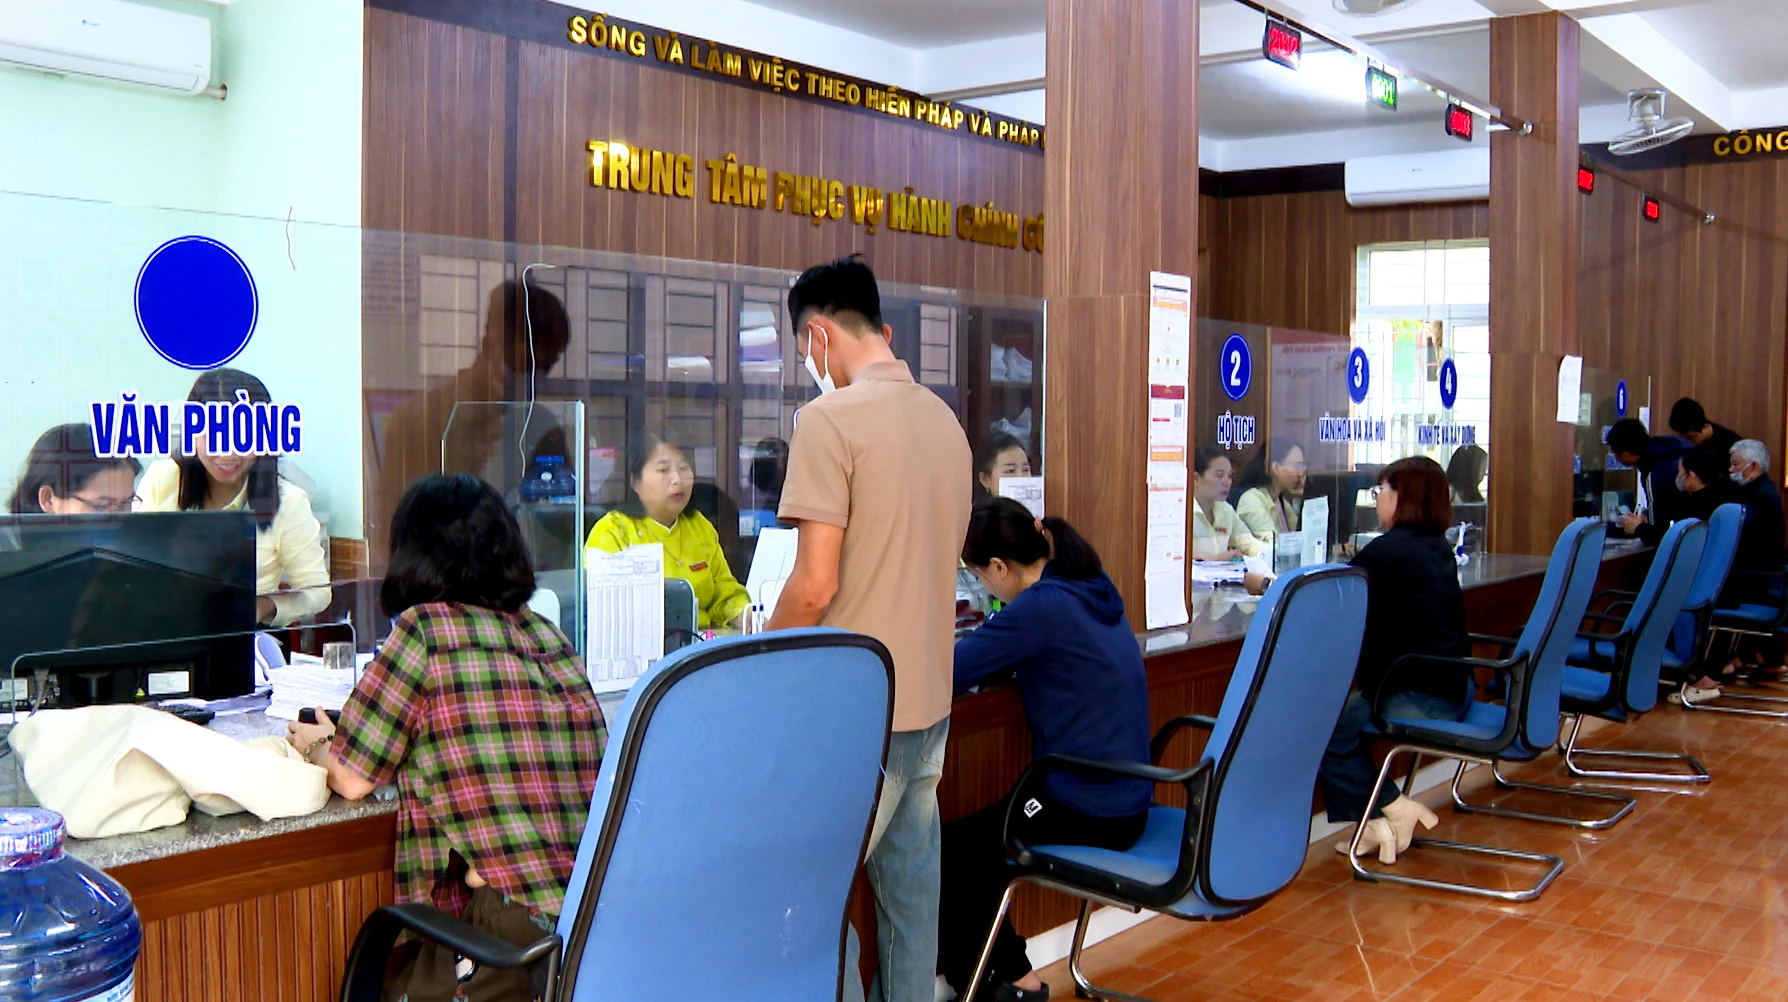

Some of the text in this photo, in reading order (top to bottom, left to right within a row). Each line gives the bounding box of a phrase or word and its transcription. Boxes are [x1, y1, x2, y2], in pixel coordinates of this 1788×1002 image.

[568, 13, 646, 56] SỐNG
[653, 31, 684, 64] VÀ
[690, 40, 741, 77] LÀM
[748, 56, 800, 92] VIỆC
[805, 72, 861, 105] THEO
[865, 85, 910, 118] HIẾN
[915, 100, 963, 129] PHÁP
[968, 109, 992, 137] VÀ
[998, 120, 1039, 147] PHÁP
[1713, 129, 1788, 156] CÔNG
[586, 139, 694, 199] TRUNG
[706, 152, 767, 209] TÂM
[774, 170, 845, 227] PHỤC
[847, 185, 884, 235] VỤ
[887, 186, 951, 237] HÀNH
[957, 201, 1018, 250] CHÍNH
[1231, 350, 1241, 386] 2
[1354, 356, 1363, 388] 3
[1445, 367, 1452, 394] 4
[90, 390, 302, 457] VĂN PHÒNG
[1218, 410, 1255, 449] HỘ TỊCH
[1319, 411, 1335, 442] VĂN
[1353, 416, 1362, 441] VÀ
[1418, 425, 1432, 444] KINH
